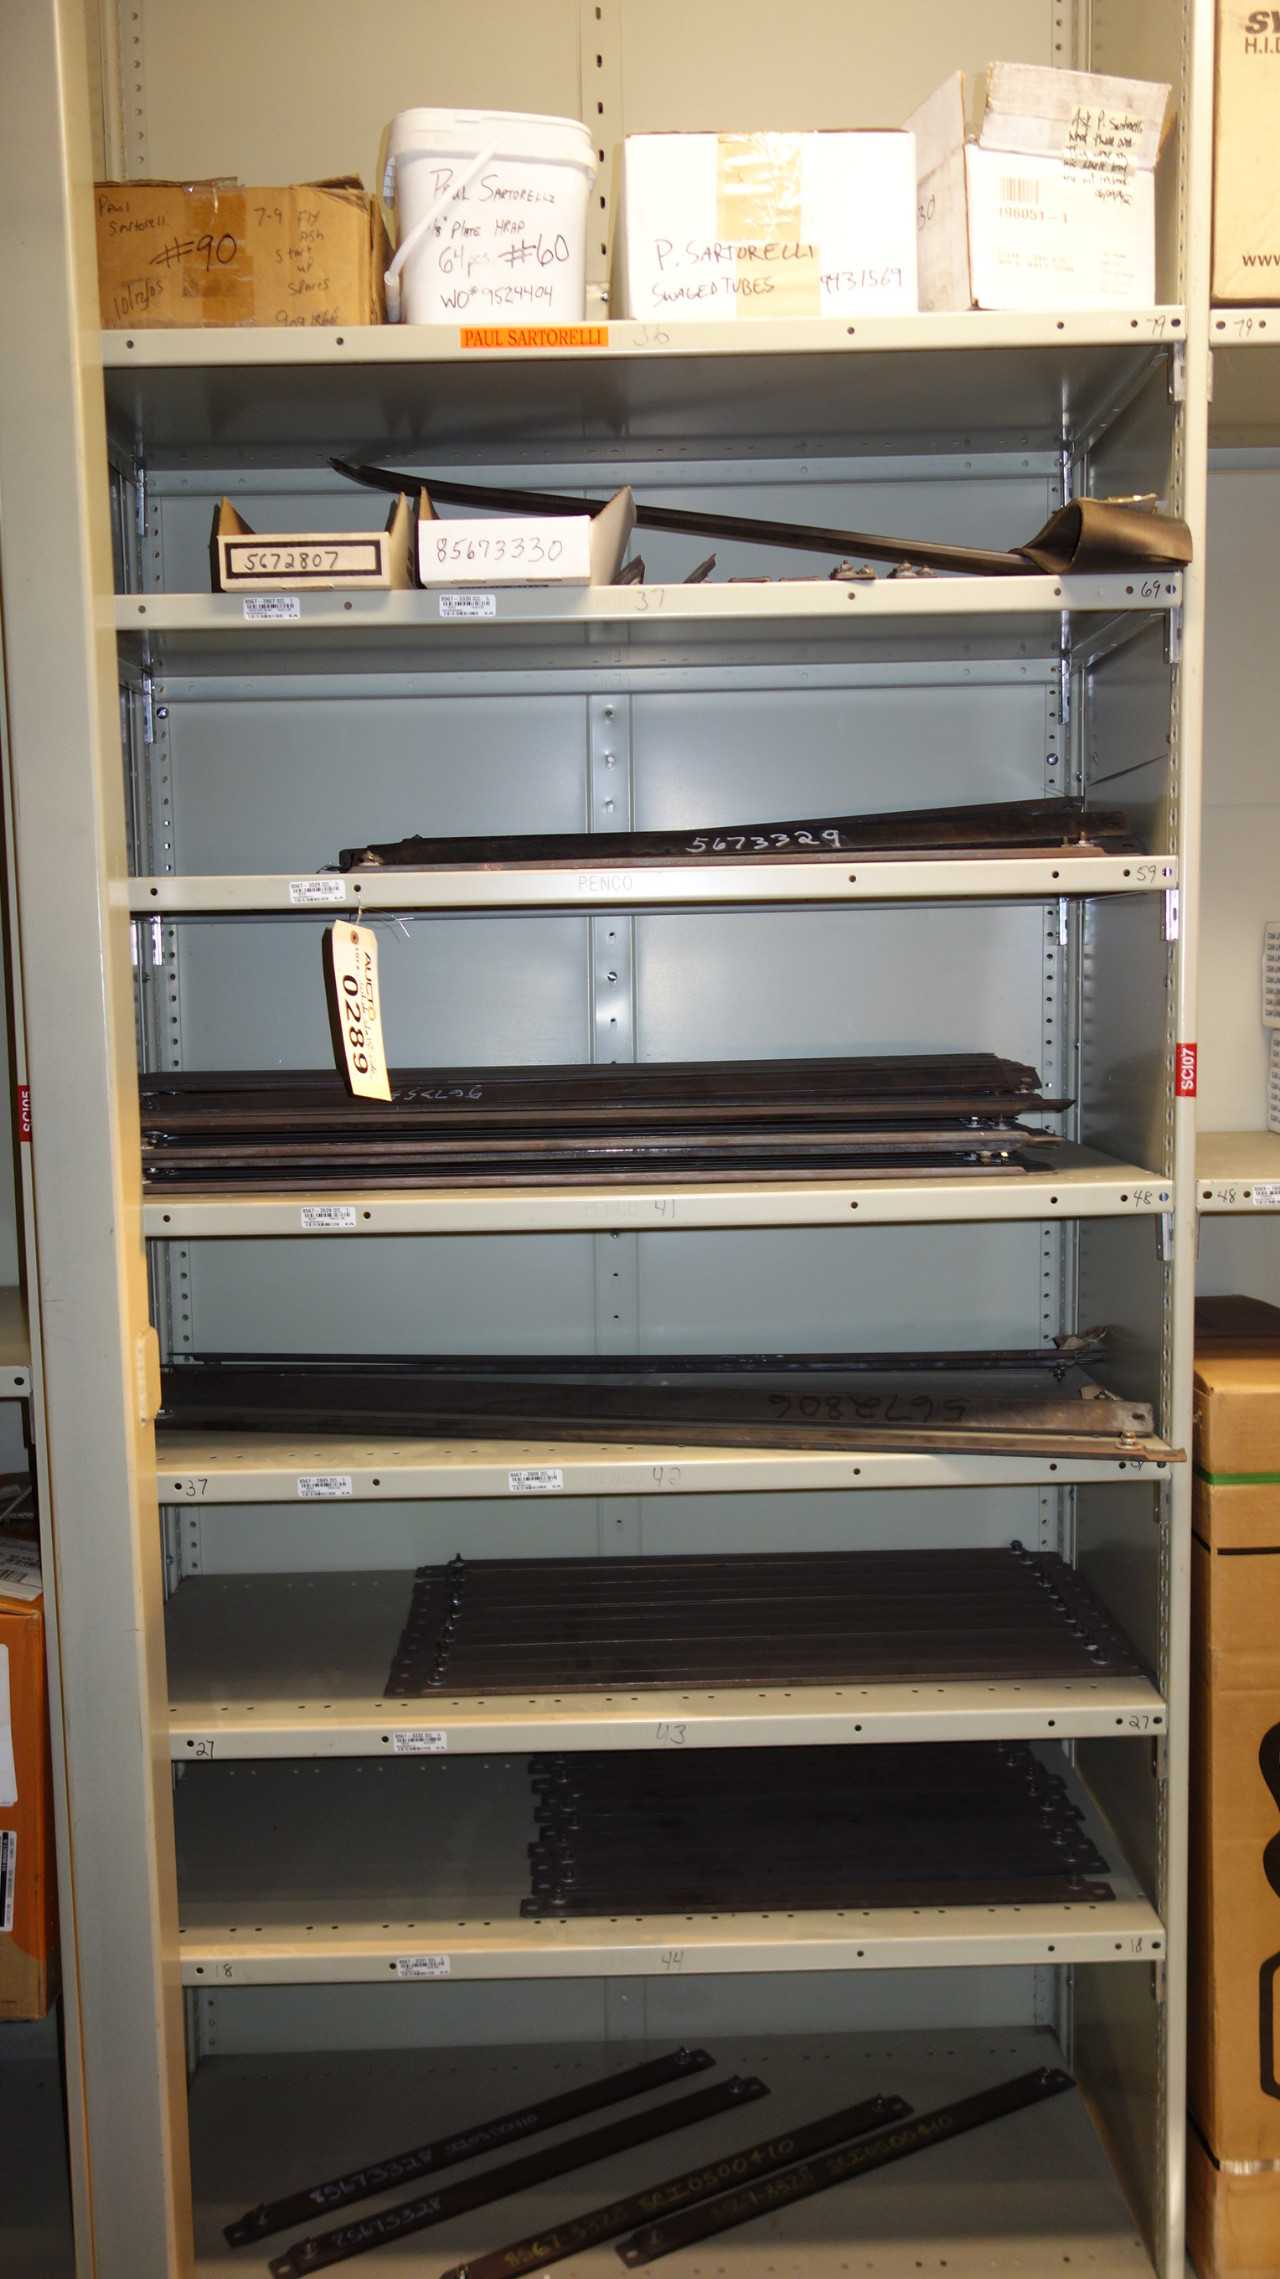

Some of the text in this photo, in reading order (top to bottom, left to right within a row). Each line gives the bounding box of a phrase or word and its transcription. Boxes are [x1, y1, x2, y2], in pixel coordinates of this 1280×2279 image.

[149, 233, 238, 273] #90
[464, 327, 602, 346] PAUL SARTORELLI
[435, 536, 564, 564] 85673330
[244, 550, 340, 572] 5672807
[1140, 579, 1161, 599] 69
[685, 828, 843, 853] 5673329
[1135, 863, 1158, 883] 59
[341, 974, 370, 1076] 0289
[1181, 1047, 1196, 1091] SCI07
[1132, 1189, 1154, 1207] 48
[1216, 1187, 1237, 1204] 48
[185, 1477, 209, 1498] 37
[1128, 1713, 1150, 1730] 27
[655, 1722, 687, 1746] 43
[195, 1740, 215, 1760] 27
[660, 1950, 685, 1971] 44
